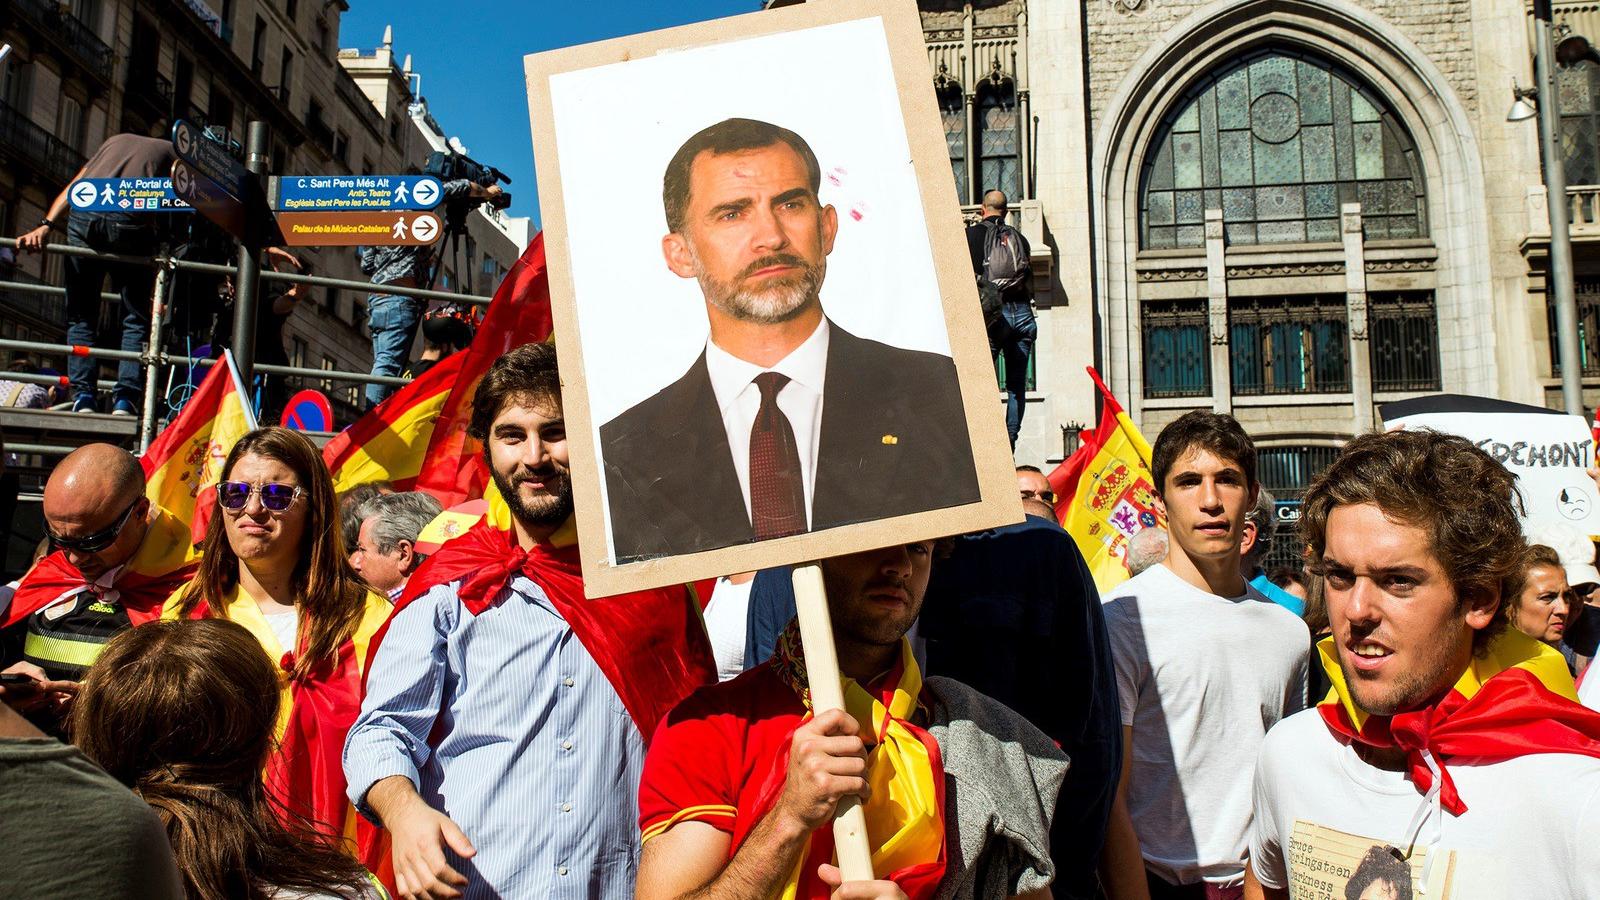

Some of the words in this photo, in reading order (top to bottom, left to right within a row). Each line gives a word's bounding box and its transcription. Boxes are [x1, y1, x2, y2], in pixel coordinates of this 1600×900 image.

[119, 180, 133, 189] Av.
[135, 180, 162, 189] Portal
[298, 179, 308, 188] C.
[310, 179, 331, 188] Sant
[333, 179, 354, 188] Pere
[356, 178, 375, 188] Més
[377, 178, 390, 188] Alt
[129, 190, 165, 199] Catalunya
[348, 189, 367, 197] Antic
[369, 189, 392, 197] Teatre
[161, 199, 172, 207] Pl.
[315, 198, 333, 207] Sant
[333, 199, 351, 207] Pere
[351, 199, 362, 207] les
[292, 225, 314, 233] Palau
[313, 225, 324, 233] de
[323, 225, 331, 233] la
[331, 224, 358, 233] Música
[358, 225, 391, 233] Catalana
[1475, 438, 1593, 468] DEMONT
[88, 604, 115, 614] adidas
